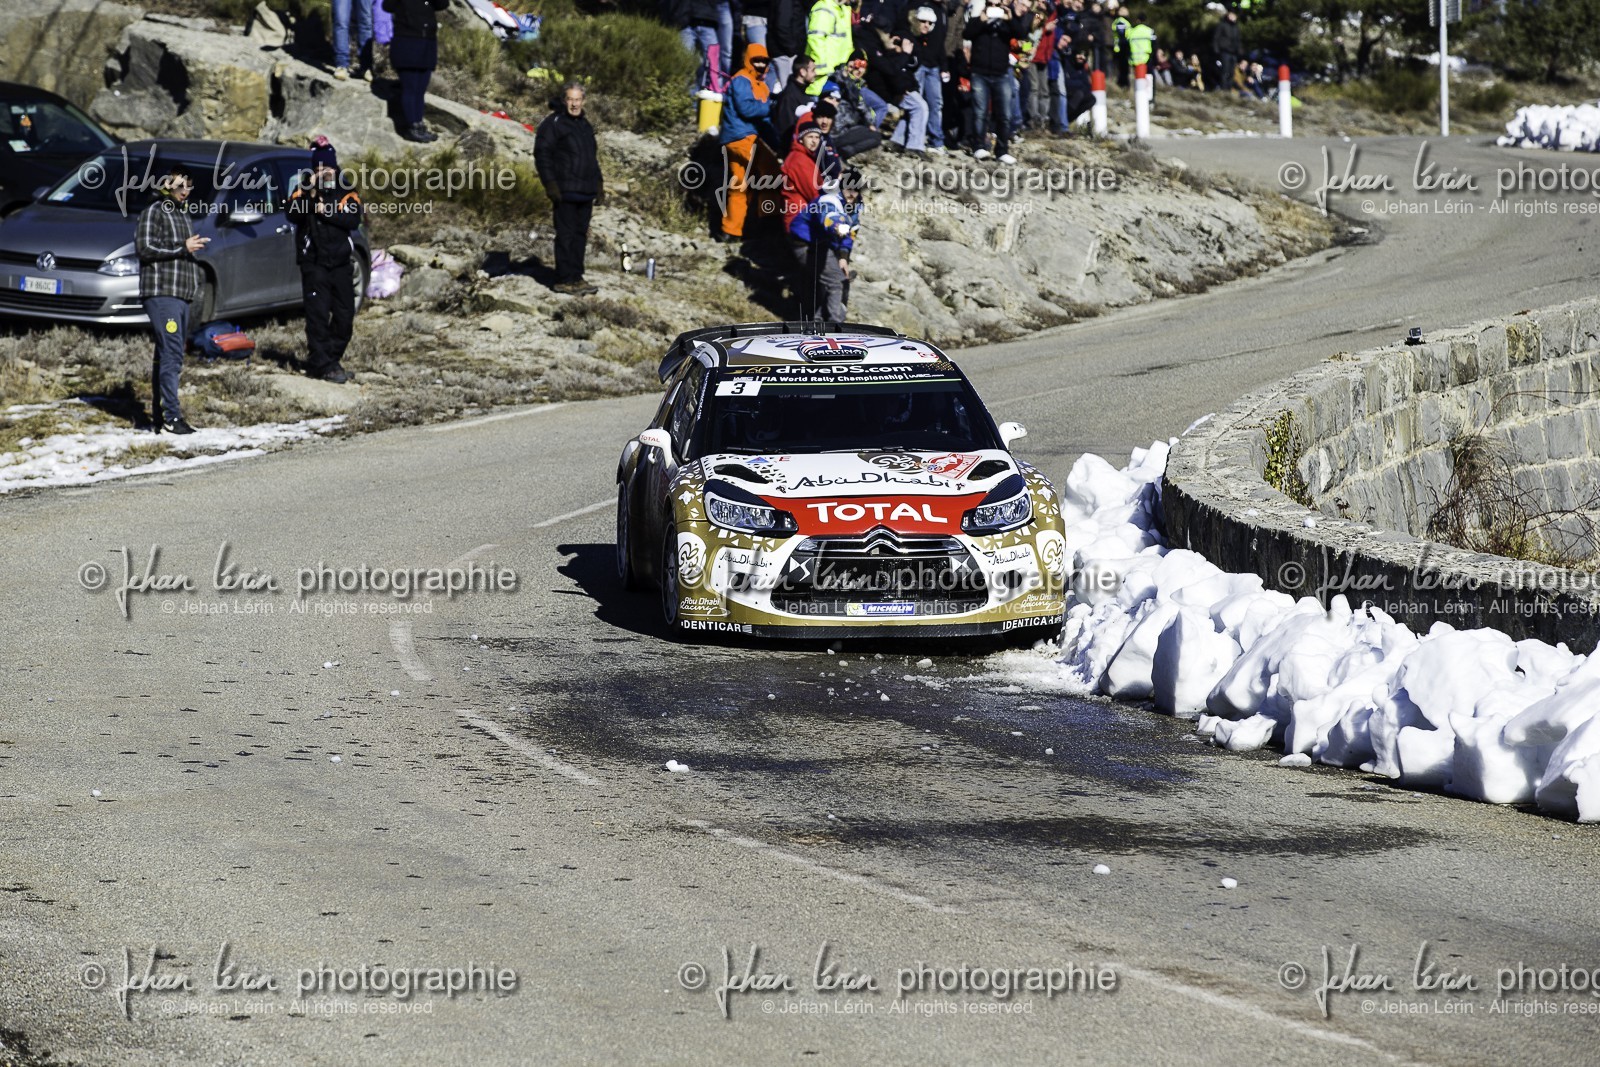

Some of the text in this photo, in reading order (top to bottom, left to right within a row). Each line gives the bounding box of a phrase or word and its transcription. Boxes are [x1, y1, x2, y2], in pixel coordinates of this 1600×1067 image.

[776, 365, 913, 374] driveDS.com
[837, 374, 904, 382] Championship
[731, 382, 746, 395] 3
[640, 434, 661, 443] TOTAL
[787, 471, 950, 491] Abu Dhabi
[806, 501, 948, 524] TOTAL
[684, 597, 720, 606] Abu Dhabi
[1026, 594, 1039, 602] Abu
[680, 601, 718, 615] Racing
[867, 605, 914, 613] MICHELIN
[1020, 600, 1055, 610] Racing
